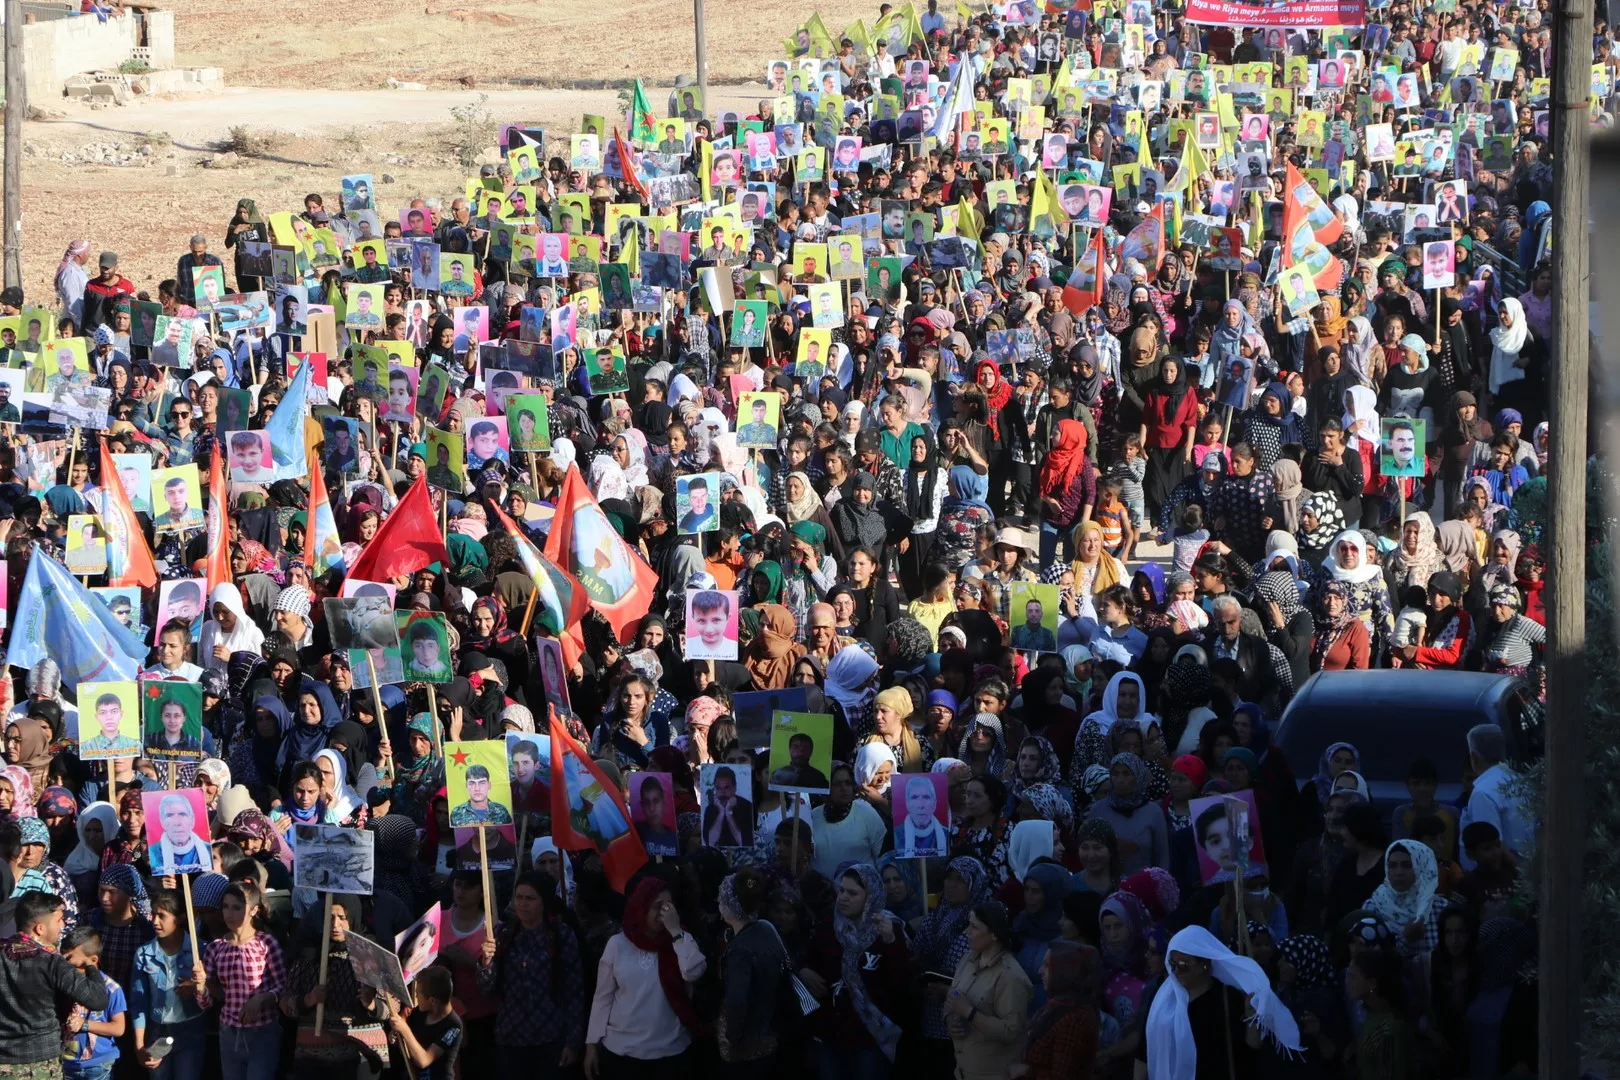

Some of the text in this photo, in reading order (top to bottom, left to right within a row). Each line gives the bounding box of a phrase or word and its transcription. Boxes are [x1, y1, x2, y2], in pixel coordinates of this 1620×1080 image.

[1210, 3, 1220, 11] we
[1222, 4, 1239, 15] Riya
[1240, 8, 1259, 17] meye
[1291, 5, 1303, 13] we
[1304, 4, 1339, 12] Armanca
[1340, 5, 1360, 13] meye
